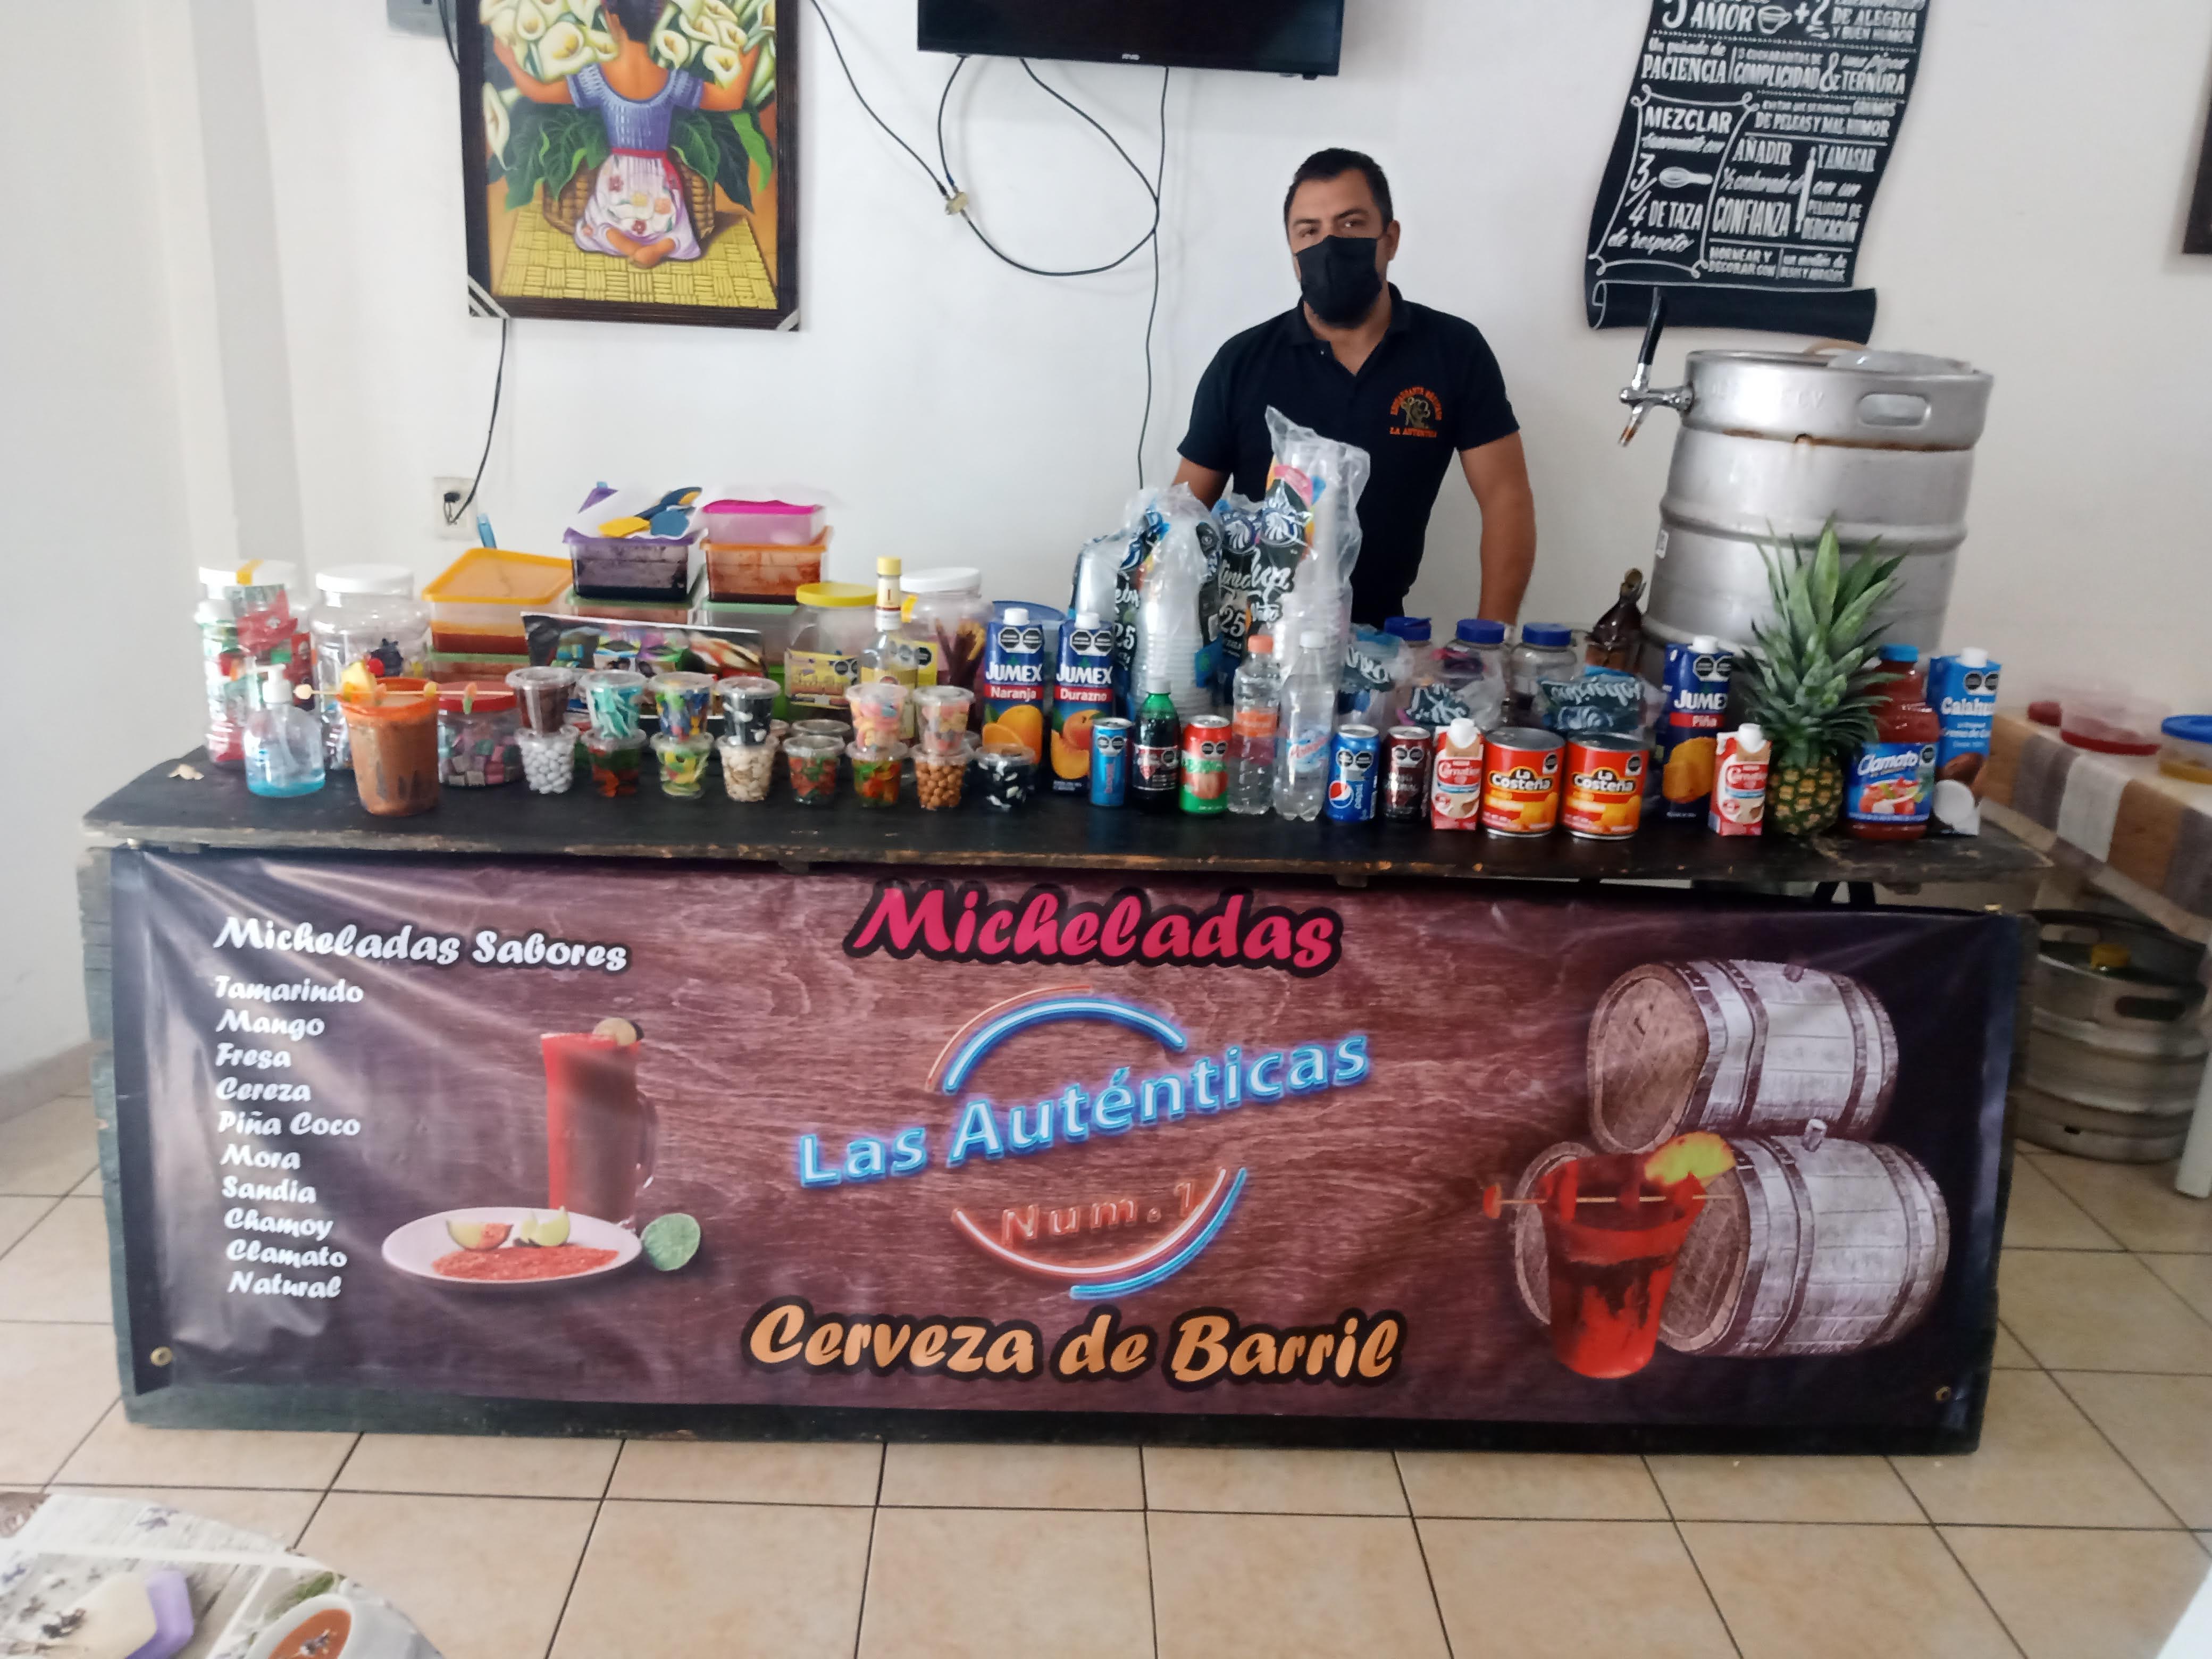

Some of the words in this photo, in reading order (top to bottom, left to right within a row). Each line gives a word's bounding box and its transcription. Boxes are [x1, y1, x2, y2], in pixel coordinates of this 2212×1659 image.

[1690, 2, 1755, 32] AMOR
[1641, 54, 1727, 83] PACIENCIA
[1842, 69, 1906, 95] TERNURA
[1645, 106, 1732, 134] MEZCLAR
[1649, 200, 1668, 228] DE
[1668, 202, 1704, 231] TAZA
[1712, 196, 1792, 238] CONFIANZA
[1631, 230, 1695, 255] respeto
[1219, 605, 1246, 638] 25
[985, 661, 1043, 683] JUMEX
[1055, 663, 1113, 685] JUMEX
[991, 685, 1037, 702] Naranja
[1060, 687, 1108, 701] Durazno
[1515, 769, 1531, 780] La
[1597, 769, 1613, 781] La
[1857, 750, 1919, 776] Clamato
[1492, 774, 1551, 790] Costeña
[1574, 774, 1635, 791] Costeña
[853, 887, 1334, 969] Micheladas
[213, 917, 461, 966] Micheladas
[472, 930, 628, 971] Sabores
[215, 975, 364, 1002] Tamarindo
[216, 1009, 325, 1041] Mango
[215, 1042, 291, 1069] Fresa
[216, 1077, 311, 1101] Cereza
[217, 1110, 282, 1136] Piña
[290, 1111, 361, 1136] Coco
[799, 1126, 927, 1187] Las
[946, 1035, 1370, 1167] Auténticas
[220, 1143, 301, 1170] Mora
[224, 1207, 333, 1241] Chamoy
[1001, 1196, 1163, 1247] Num.
[1173, 1178, 1197, 1221] 1
[225, 1238, 347, 1268] Clamato
[227, 1270, 342, 1298] Natural
[749, 1303, 1037, 1374] Cerveza
[1058, 1314, 1149, 1375] de
[1169, 1315, 1400, 1382] Barril
